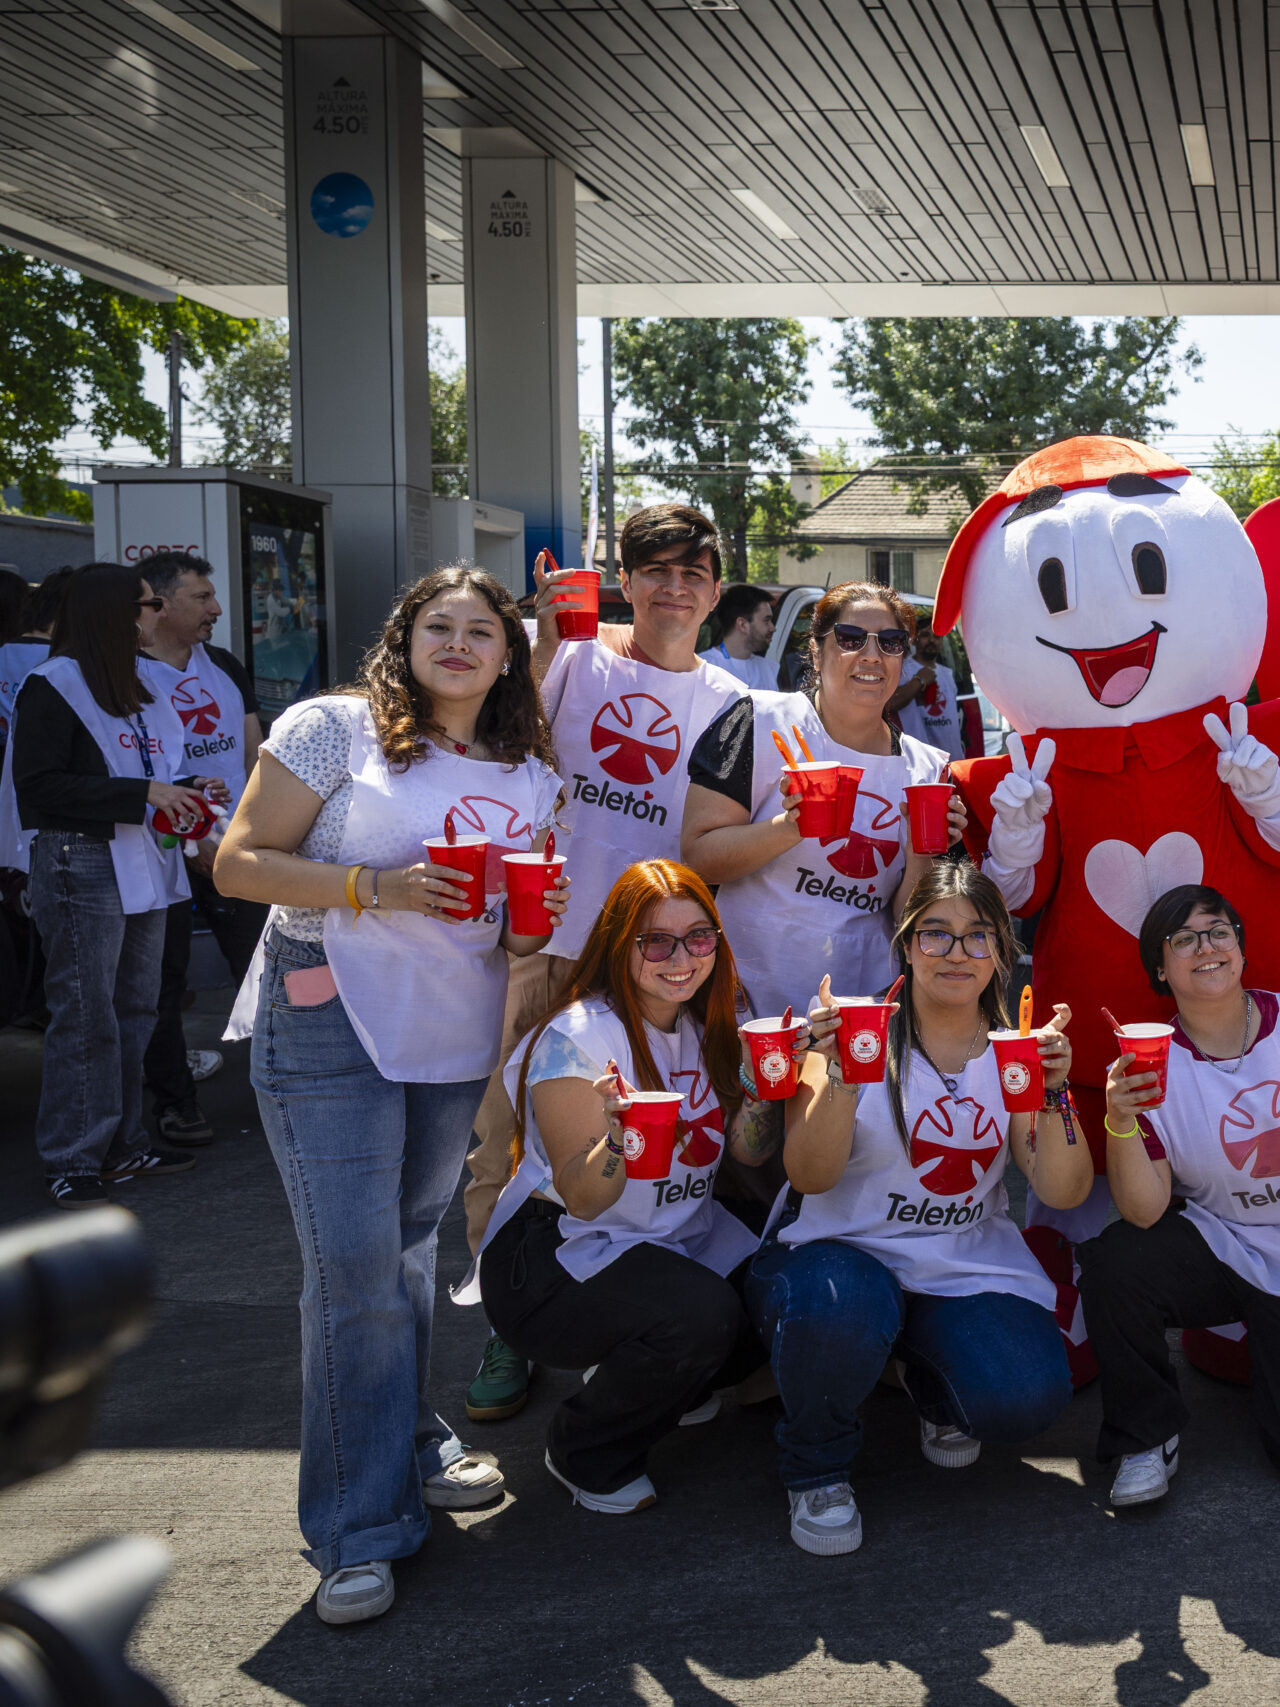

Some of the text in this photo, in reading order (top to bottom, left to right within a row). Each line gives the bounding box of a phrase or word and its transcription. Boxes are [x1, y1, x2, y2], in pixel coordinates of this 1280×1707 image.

[318, 90, 367, 101] ALTURA
[312, 116, 360, 134] 4.50
[490, 201, 528, 210] ALTURA
[488, 221, 523, 237] 4.50
[251, 535, 277, 553] 1960
[572, 773, 668, 827] Teletón
[886, 1192, 984, 1227] Teletón
